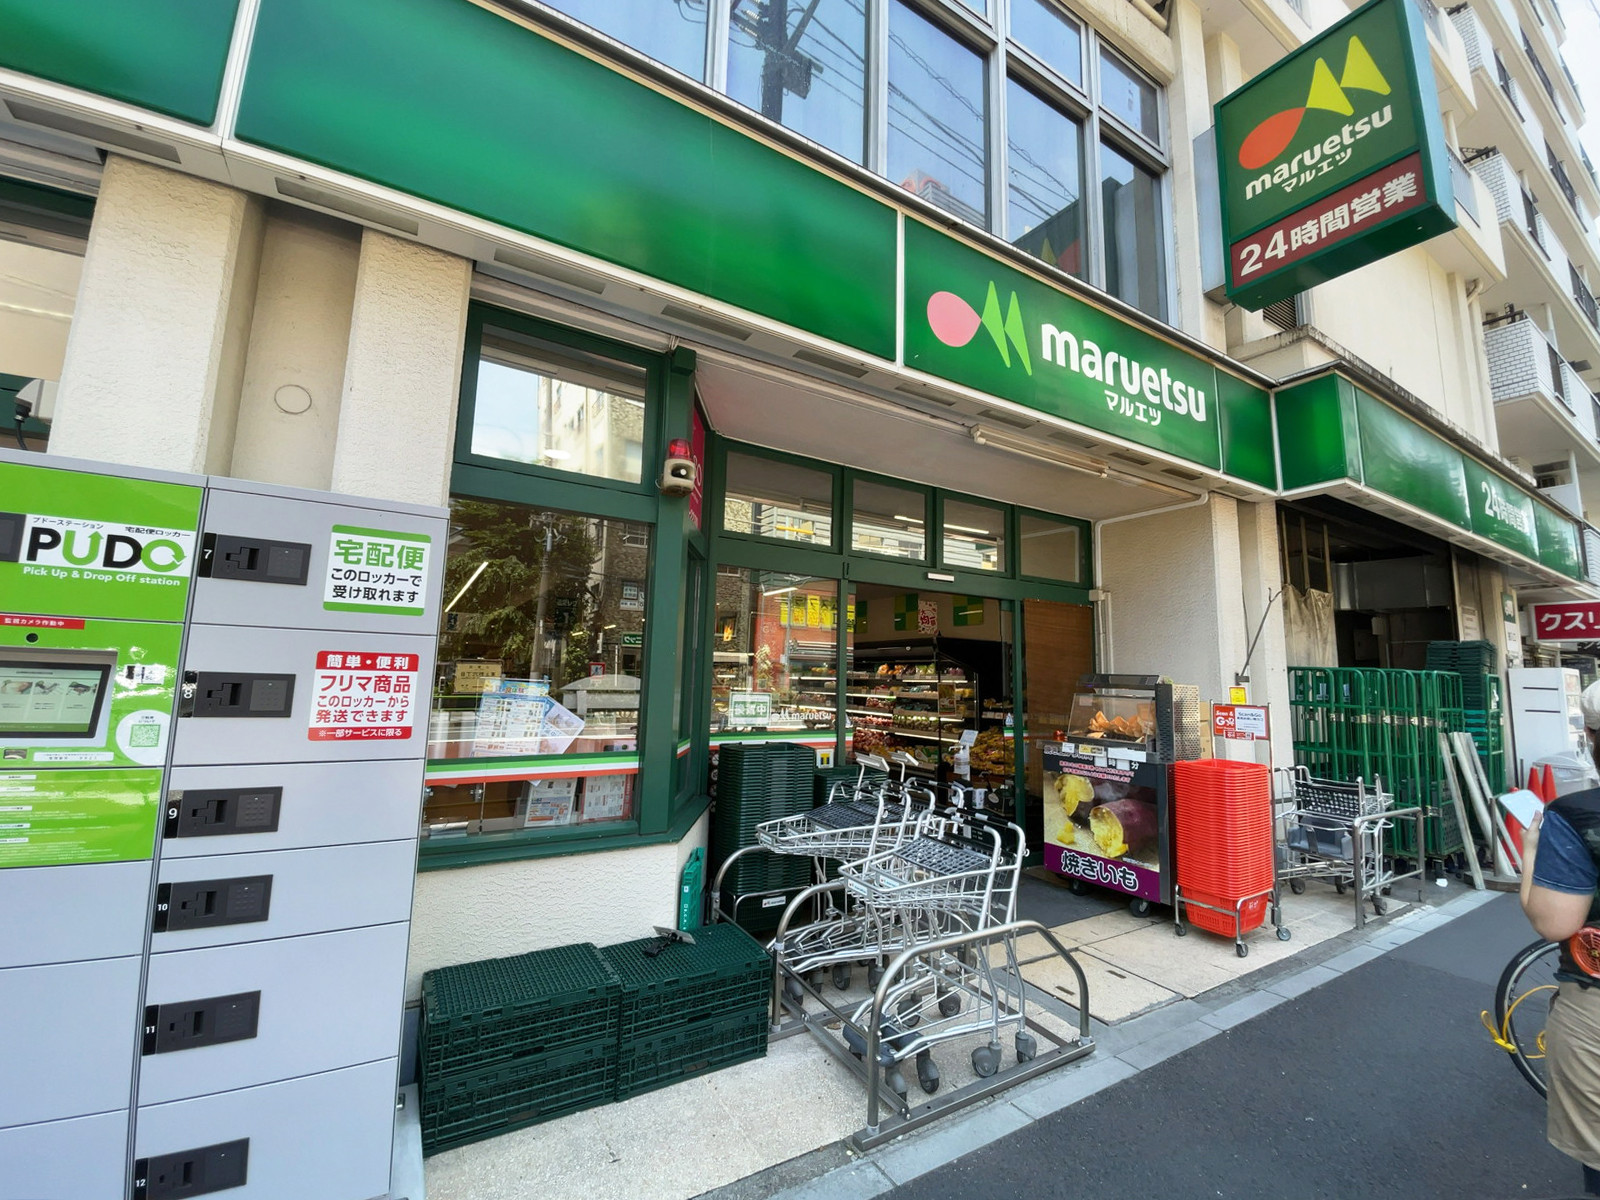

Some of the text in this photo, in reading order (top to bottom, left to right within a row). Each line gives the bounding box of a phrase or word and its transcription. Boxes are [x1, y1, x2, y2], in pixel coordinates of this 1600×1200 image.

[1245, 104, 1393, 200] maruetsu
[1281, 147, 1353, 193] マルエツ
[1239, 171, 1418, 277] 24時間営業
[1041, 323, 1206, 422] maruetsu
[1103, 389, 1162, 426] マルエツ
[203, 549, 213, 560] 7
[333, 539, 426, 571] 宅配便
[23, 566, 181, 587] Pick Up & Drop Off station
[331, 568, 423, 587] このロッカーで
[332, 585, 419, 603] 受け取れます
[326, 654, 409, 670] 簡単・便利
[320, 674, 411, 693] フリマ商品
[183, 687, 193, 699] 8
[317, 695, 410, 708] このロッカーから
[316, 709, 408, 723] 発送できます
[318, 728, 403, 738] ※一部サービスに限る
[168, 807, 178, 819] 9
[1061, 850, 1139, 892] 焼きいも
[157, 903, 168, 912] 10
[145, 1025, 156, 1035] 11
[135, 1178, 146, 1188] 12
